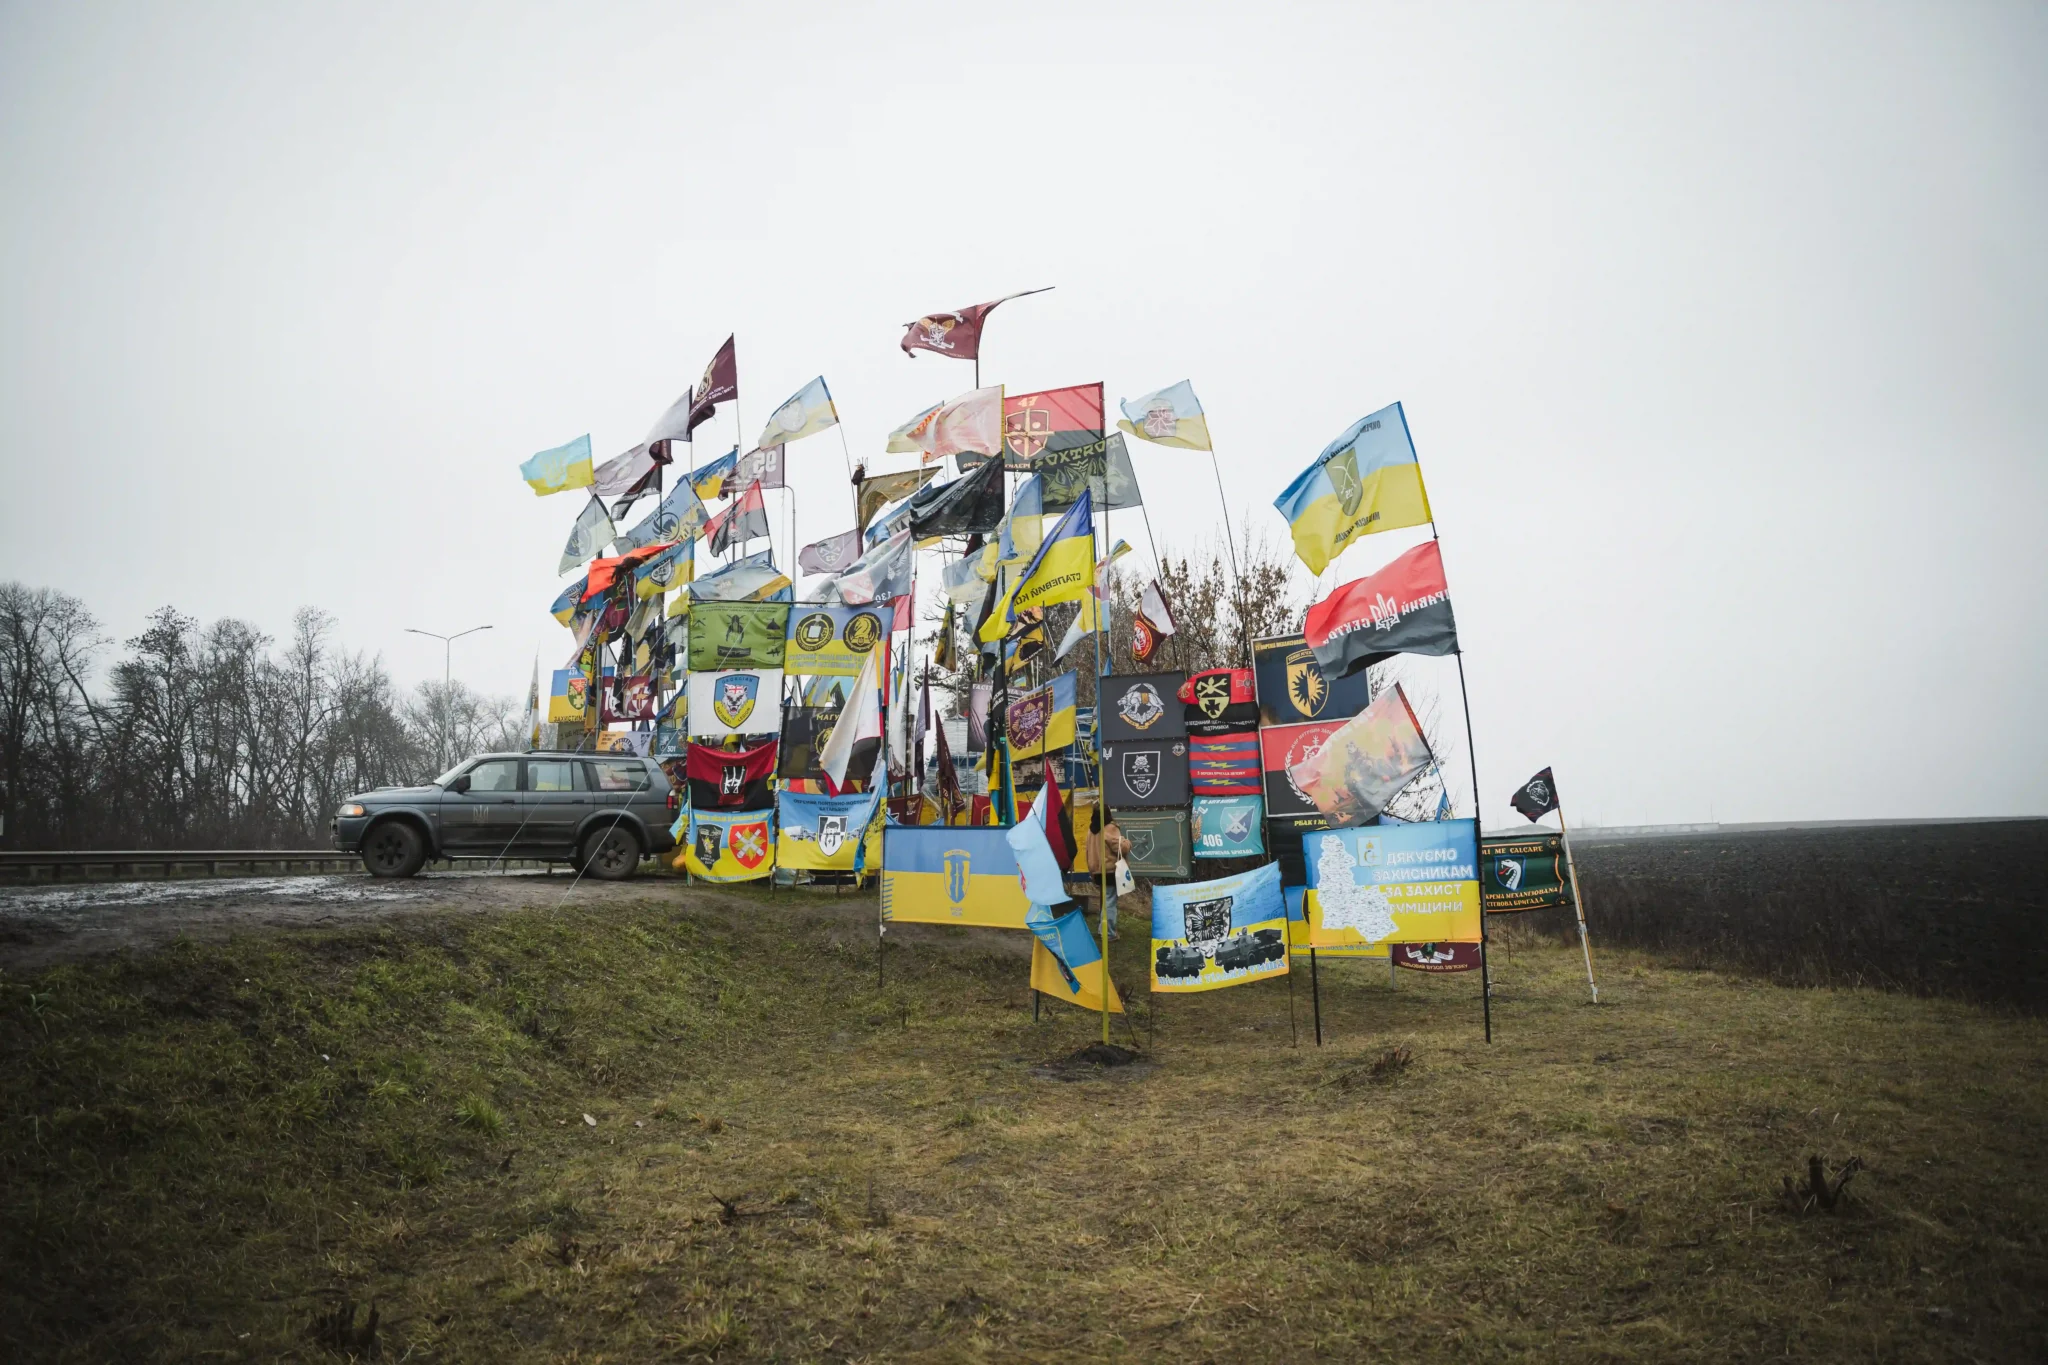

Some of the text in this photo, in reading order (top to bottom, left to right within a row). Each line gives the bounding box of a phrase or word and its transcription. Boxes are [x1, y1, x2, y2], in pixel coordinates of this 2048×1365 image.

[1017, 396, 1039, 407] 47
[722, 676, 754, 684] GEORGIAN
[716, 706, 751, 724] NATIONAL LEGION
[816, 713, 840, 721] МАГУ
[1202, 834, 1224, 847] 406
[1510, 845, 1544, 854] CALCARE
[1386, 848, 1457, 866] ДЯКУЄМО
[1372, 865, 1474, 882] ЗАХИСНИКАМ
[1386, 883, 1462, 898] ЗА ЗАХИСТ
[1485, 892, 1504, 900] КРЕМА
